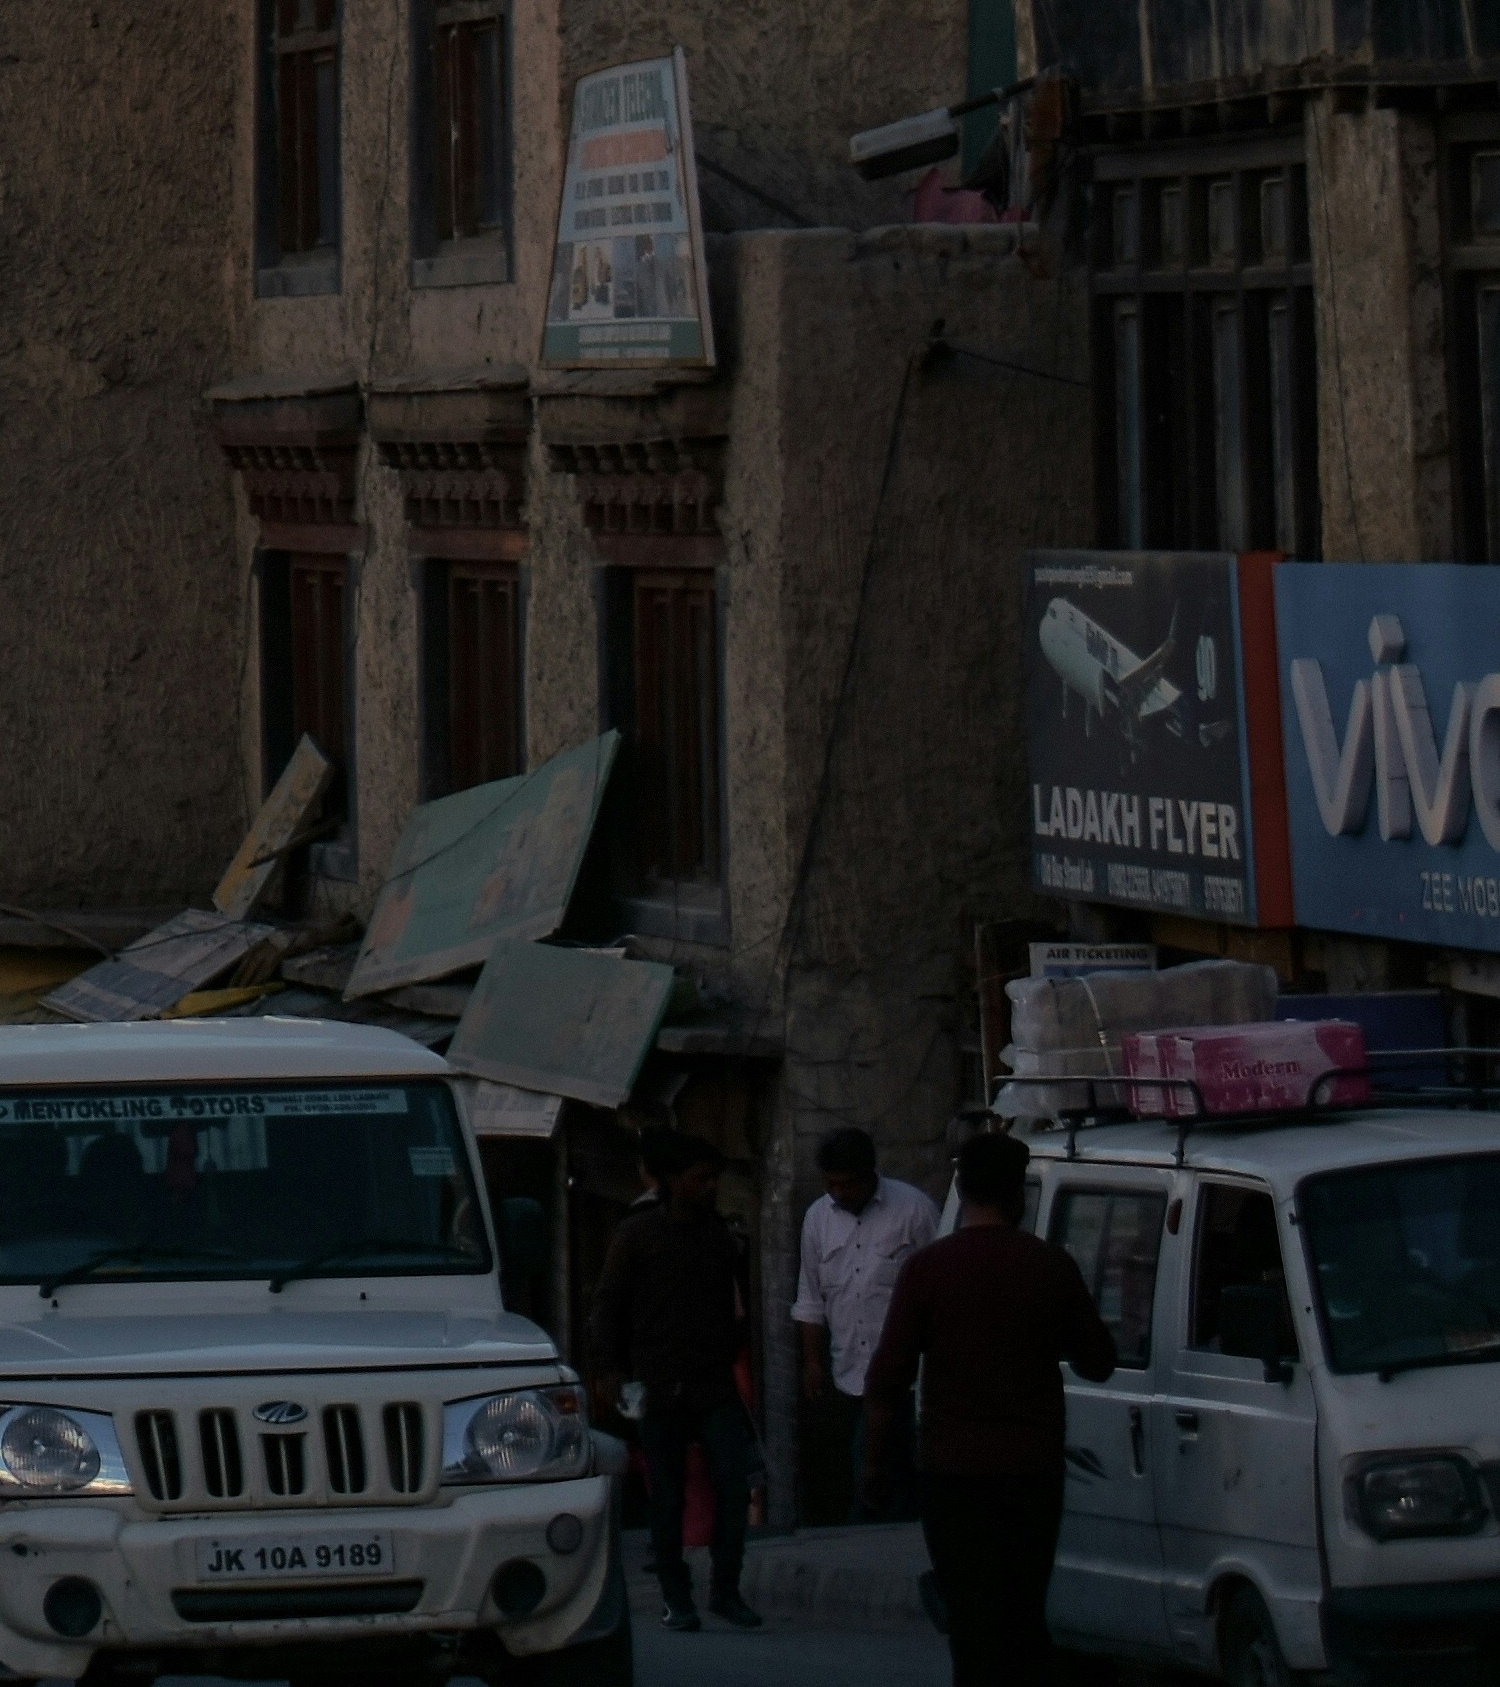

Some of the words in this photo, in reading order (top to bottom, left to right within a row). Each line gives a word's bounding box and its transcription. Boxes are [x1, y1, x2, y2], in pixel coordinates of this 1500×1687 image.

[1033, 783, 1141, 849] LADAKH
[1148, 796, 1241, 861] FLYER
[1419, 871, 1454, 912] ZEE
[1047, 948, 1069, 959] AIR
[1074, 948, 1149, 960] TICKETING
[1220, 1060, 1301, 1080] Modern
[12, 1094, 163, 1121] MENTOKLING
[207, 1548, 246, 1573] JK
[254, 1546, 308, 1572] 10A
[315, 1542, 383, 1568] 9189
